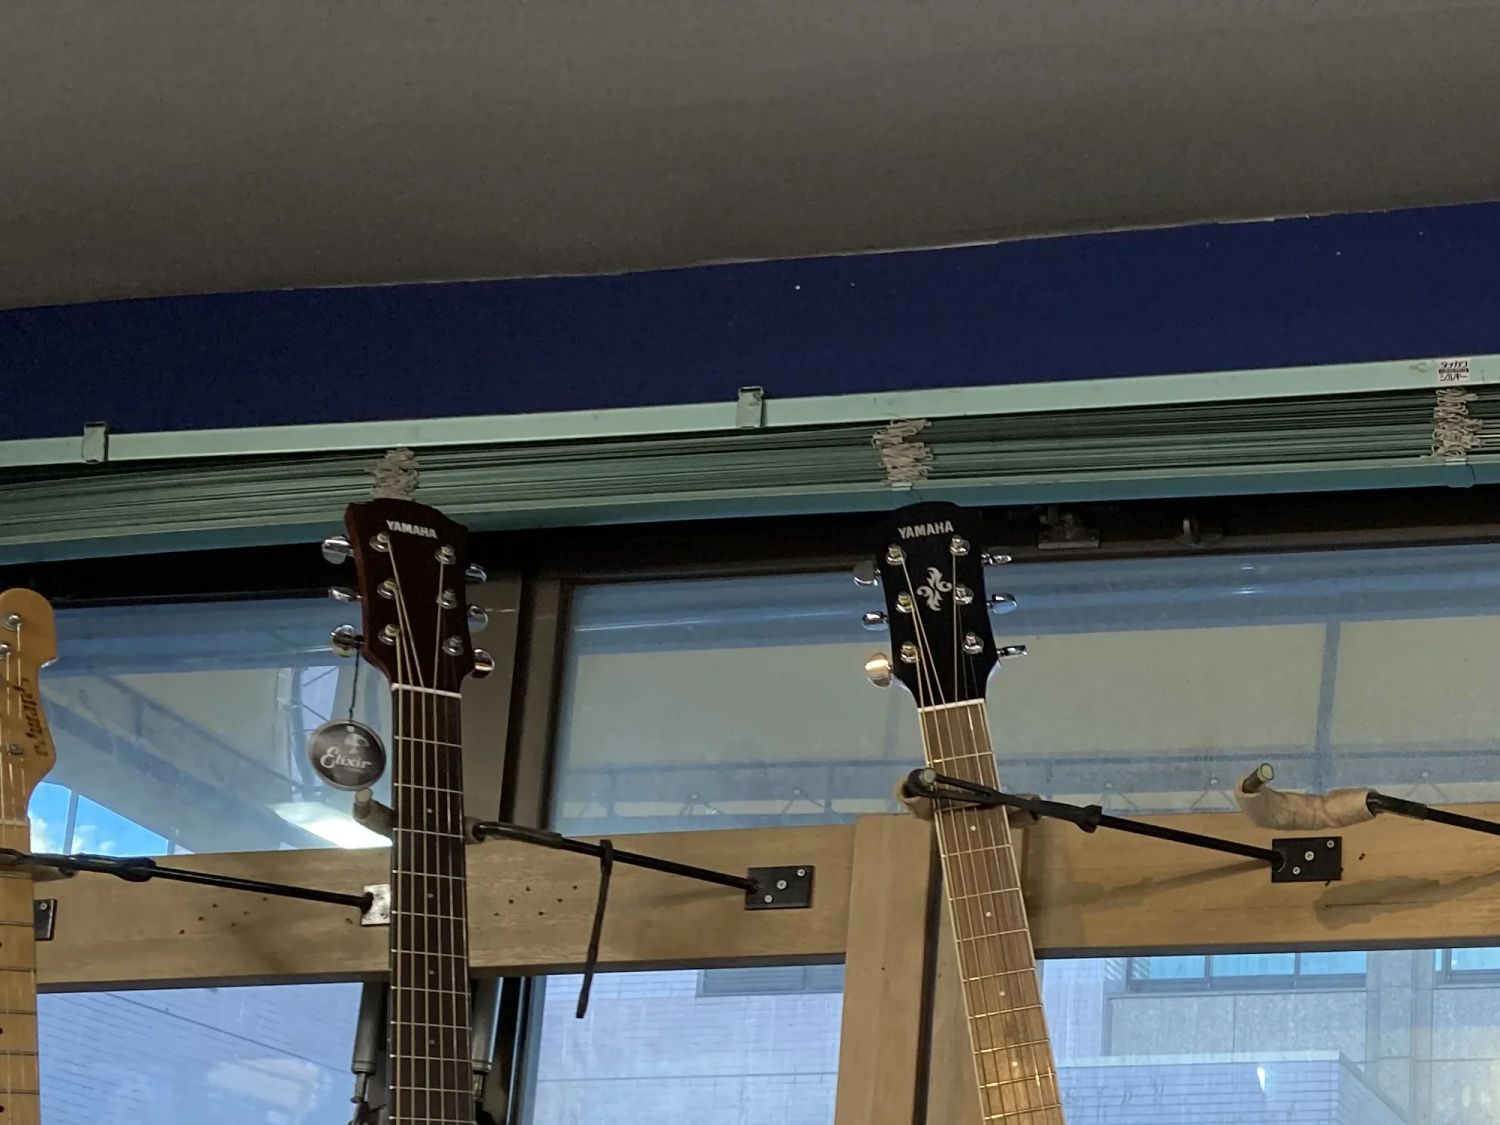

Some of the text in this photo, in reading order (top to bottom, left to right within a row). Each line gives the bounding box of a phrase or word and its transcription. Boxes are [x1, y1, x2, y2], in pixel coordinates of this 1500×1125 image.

[386, 519, 438, 540] YAMAHA
[898, 520, 954, 540] YAMAHA
[320, 746, 372, 769] Elixir
